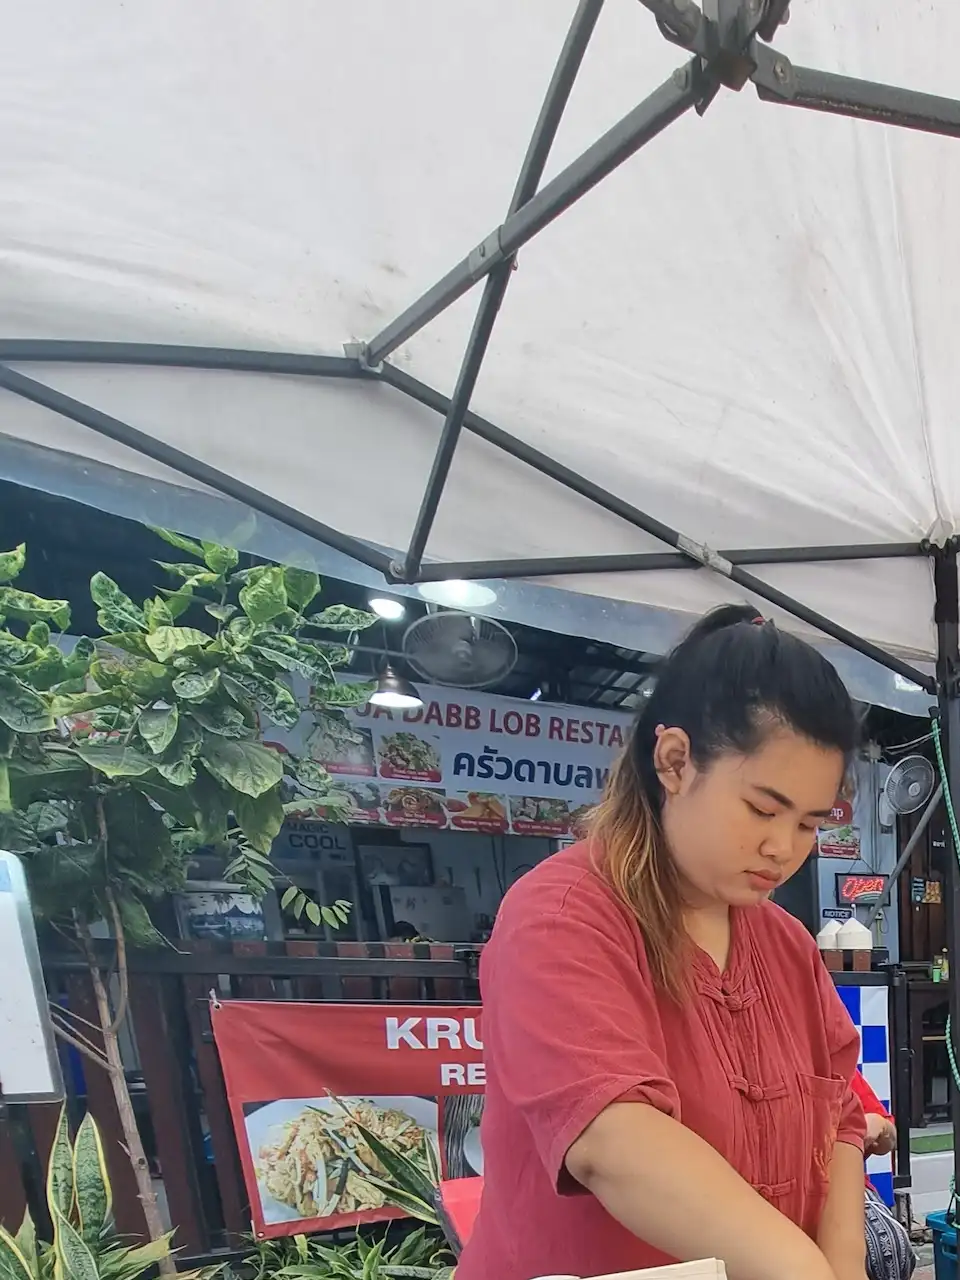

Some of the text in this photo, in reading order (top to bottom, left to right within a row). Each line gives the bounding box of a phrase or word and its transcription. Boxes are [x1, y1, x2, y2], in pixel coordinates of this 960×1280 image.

[489, 708, 541, 738] LOB
[549, 716, 632, 749] RESTA
[289, 834, 347, 851] COOL
[842, 877, 885, 902] Open
[824, 910, 850, 919] NOTICE
[440, 1063, 487, 1087] RE
